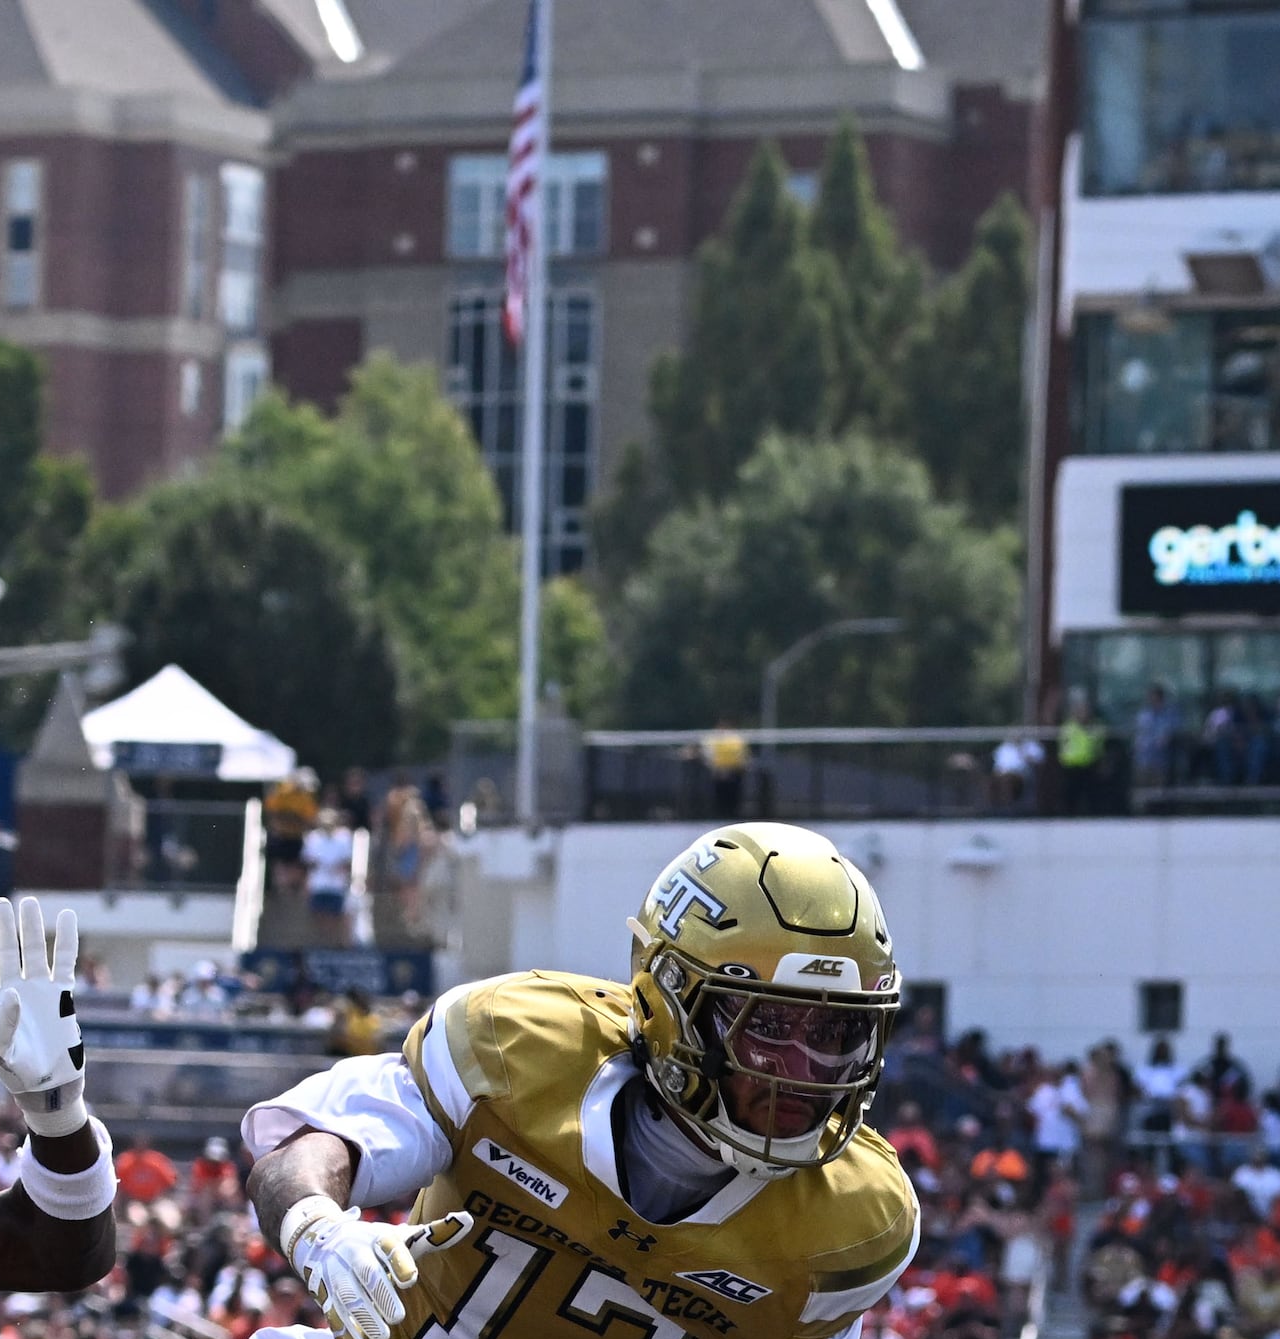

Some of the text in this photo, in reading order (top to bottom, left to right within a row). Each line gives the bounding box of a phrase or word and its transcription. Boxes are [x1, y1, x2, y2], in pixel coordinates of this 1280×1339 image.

[798, 958, 845, 977] ACC
[685, 1271, 769, 1303] ACC
[640, 1277, 738, 1335] TECH
